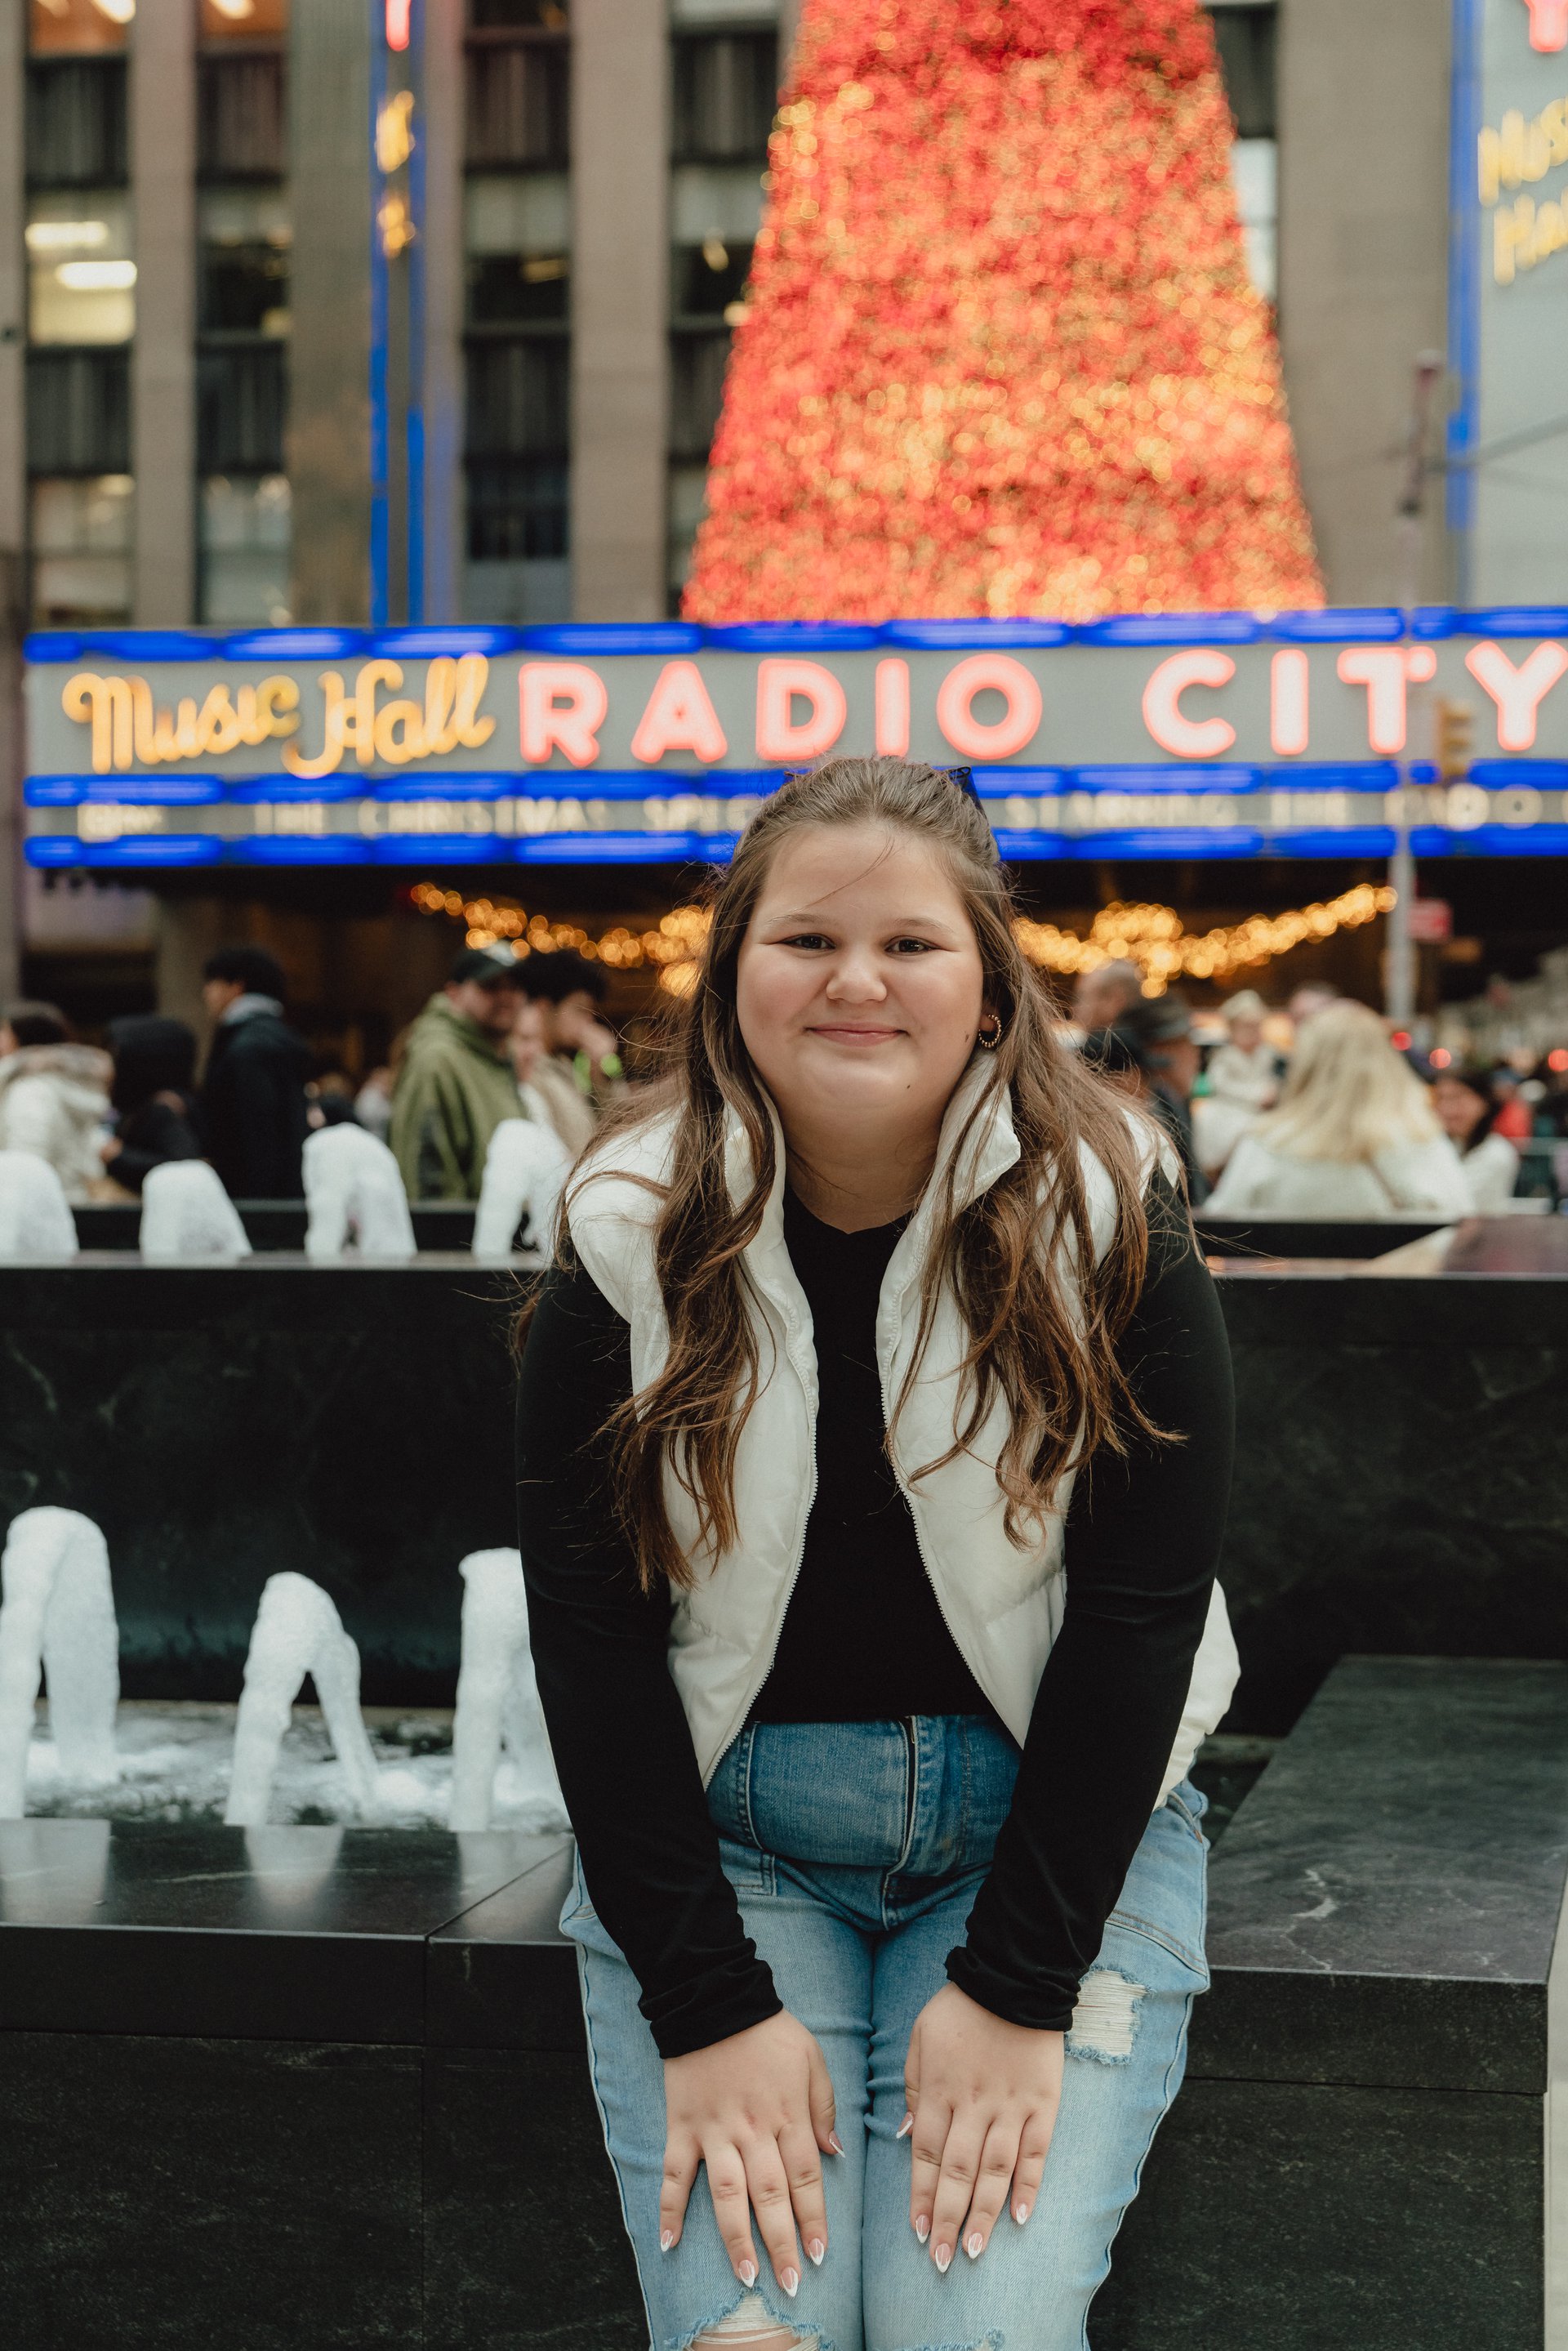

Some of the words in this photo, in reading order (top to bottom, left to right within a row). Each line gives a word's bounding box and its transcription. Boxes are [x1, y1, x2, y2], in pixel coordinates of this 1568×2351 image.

[1477, 98, 1568, 208] Mus
[62, 672, 300, 774] Music
[281, 651, 496, 778] Hall
[519, 653, 1042, 767] RADIO
[1142, 641, 1568, 759] CITY
